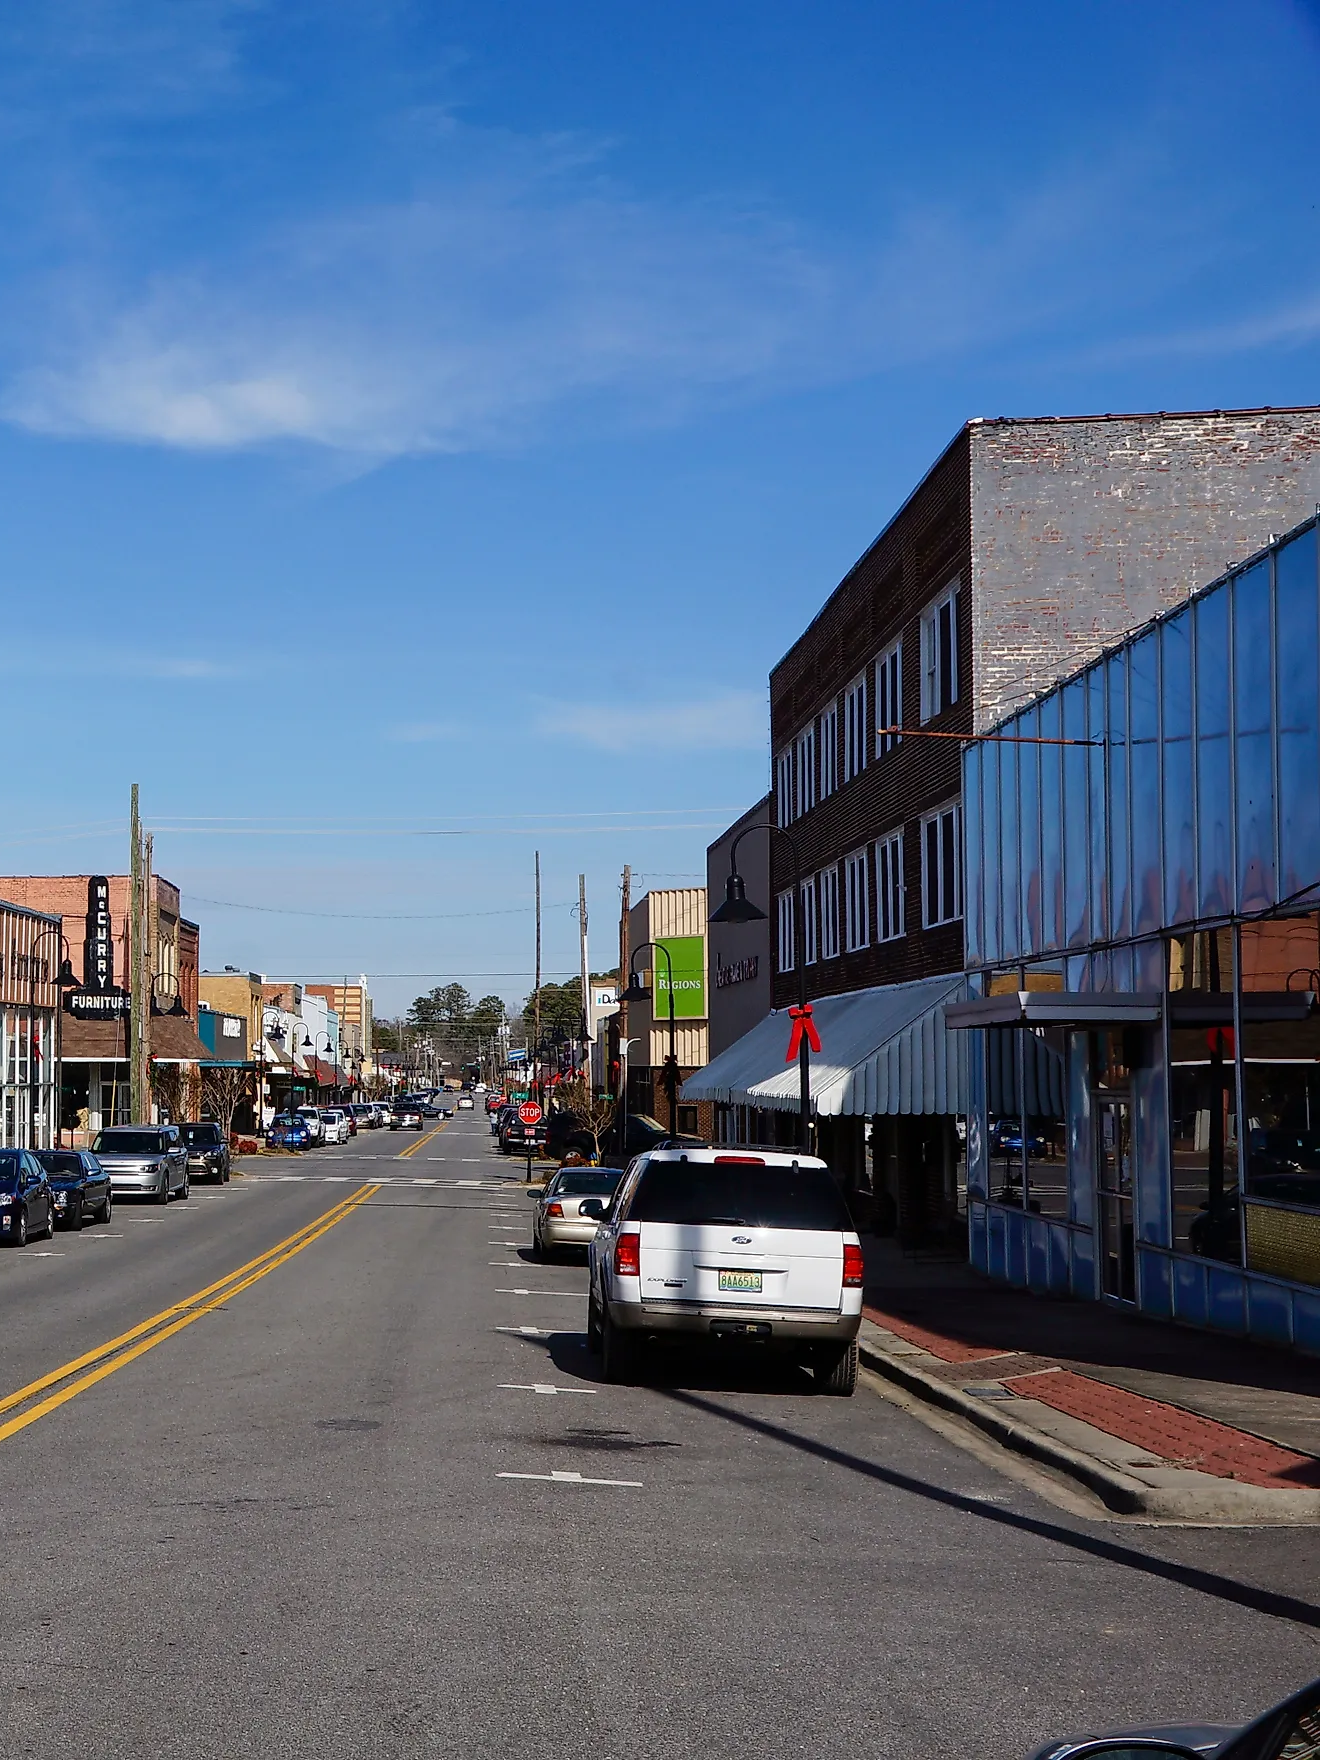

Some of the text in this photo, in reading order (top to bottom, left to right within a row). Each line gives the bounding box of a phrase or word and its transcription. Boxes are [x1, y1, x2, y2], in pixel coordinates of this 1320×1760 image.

[71, 995, 131, 1010] FURNITURE
[520, 1107, 540, 1117] STOP
[721, 1275, 760, 1288] 8AA6513
